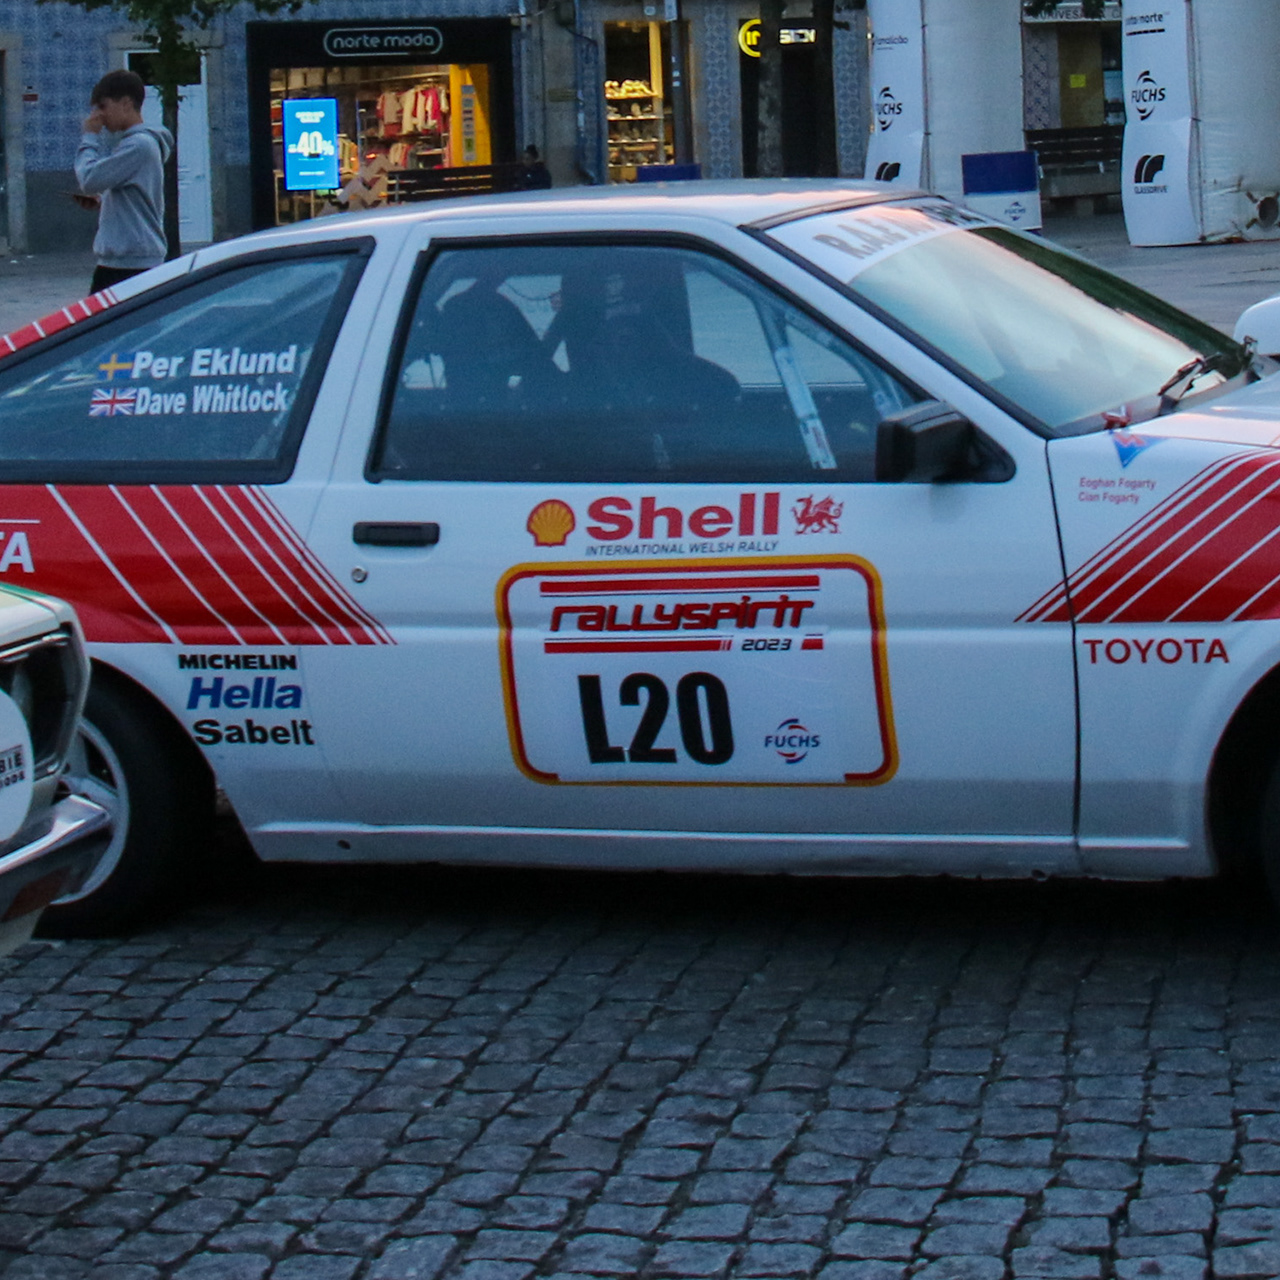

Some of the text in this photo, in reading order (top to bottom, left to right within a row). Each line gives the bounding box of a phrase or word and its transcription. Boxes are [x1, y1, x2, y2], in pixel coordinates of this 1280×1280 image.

[333, 33, 434, 49] norte moda
[1131, 88, 1166, 103] FUCHS
[876, 103, 902, 115] UCHS
[131, 344, 298, 378] Per Eklund
[134, 386, 186, 415] Dave
[1079, 477, 1157, 490] Eoghan Fogarty
[1079, 491, 1139, 505] Cian Fogarty
[586, 492, 780, 541] Shell
[586, 540, 780, 557] INTERNATIONAL WELSH RALLY
[741, 638, 793, 651] 2023
[1083, 638, 1230, 664] TOYOTA
[178, 654, 297, 670] MICHELIN
[186, 676, 302, 710] Hella
[577, 671, 735, 765] L20
[193, 718, 315, 746] Sabelt
[764, 734, 820, 748] FUCHS
